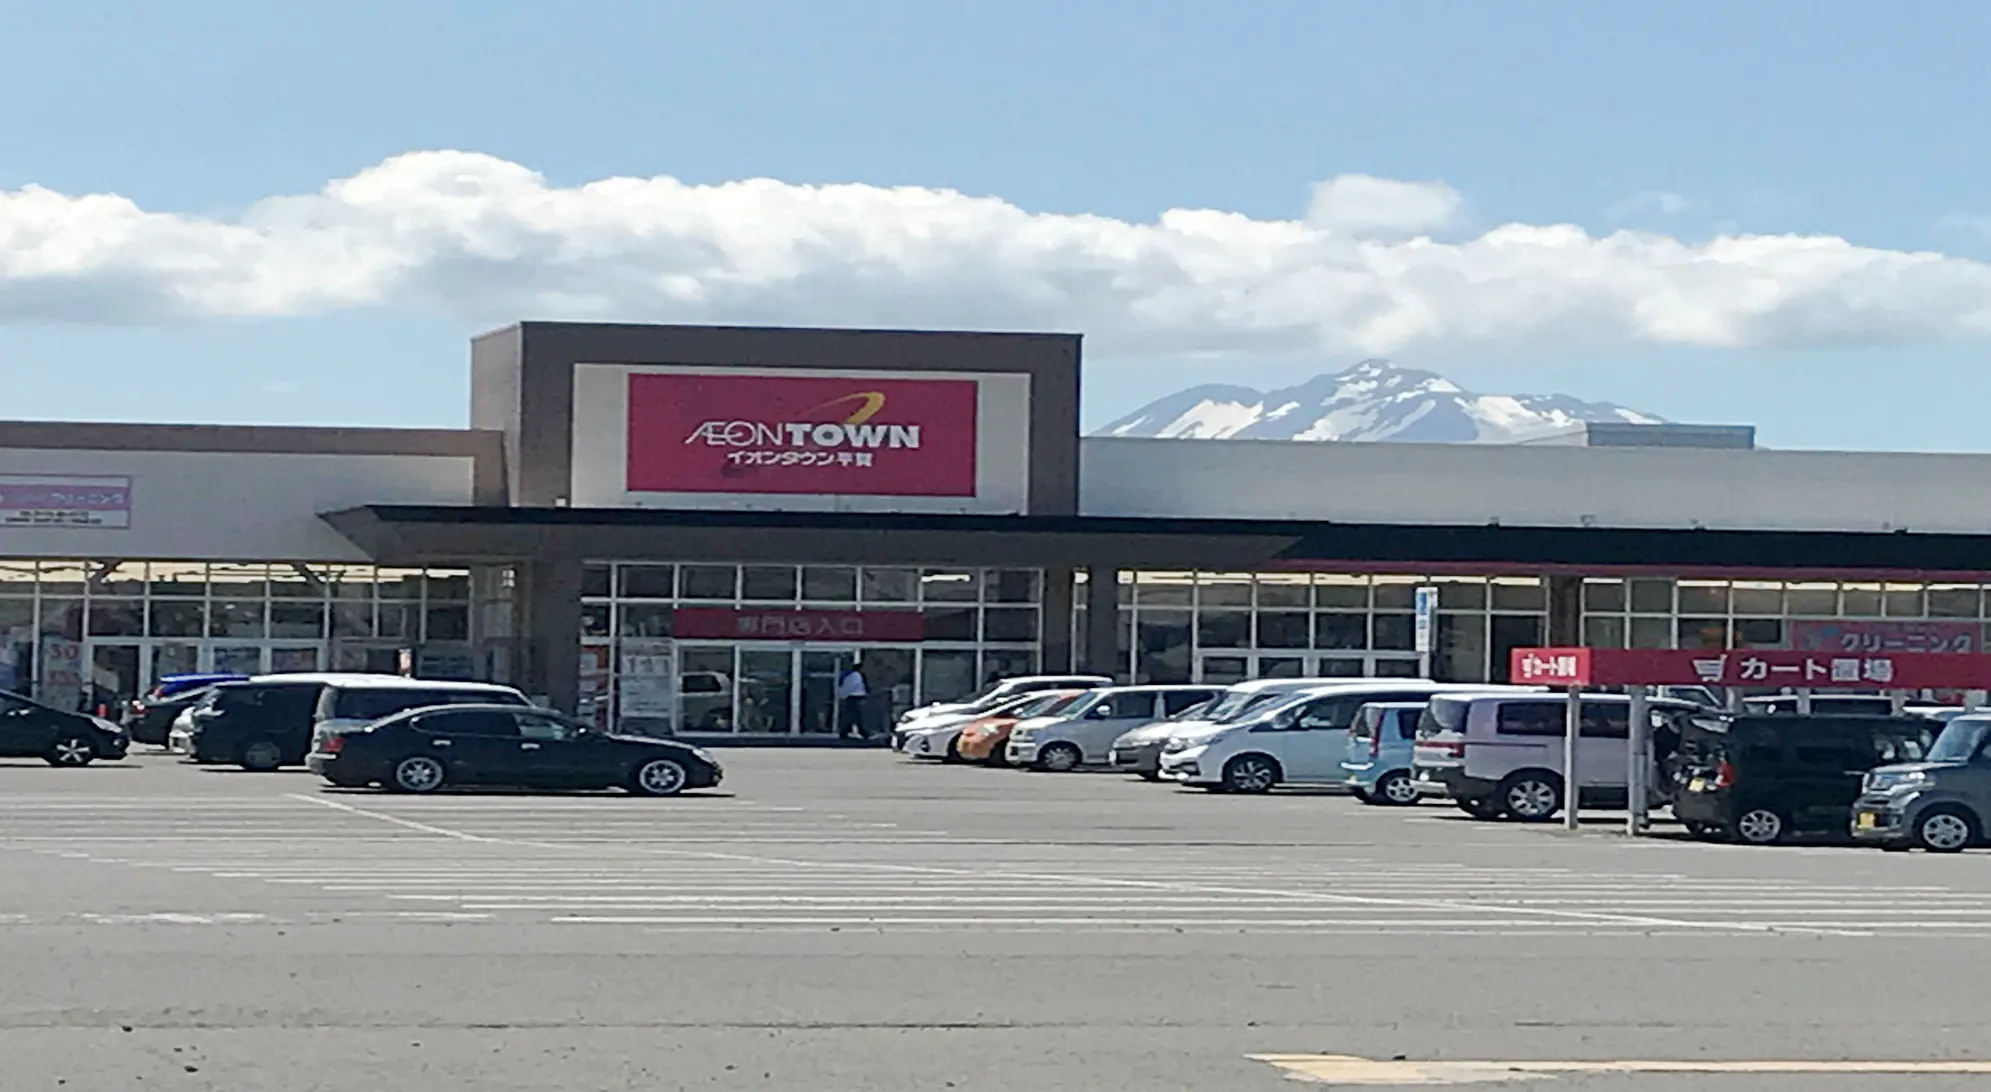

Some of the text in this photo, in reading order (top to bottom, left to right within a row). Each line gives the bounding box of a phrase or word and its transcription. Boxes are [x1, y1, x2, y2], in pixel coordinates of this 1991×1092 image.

[1740, 657, 1893, 682] カート置場
